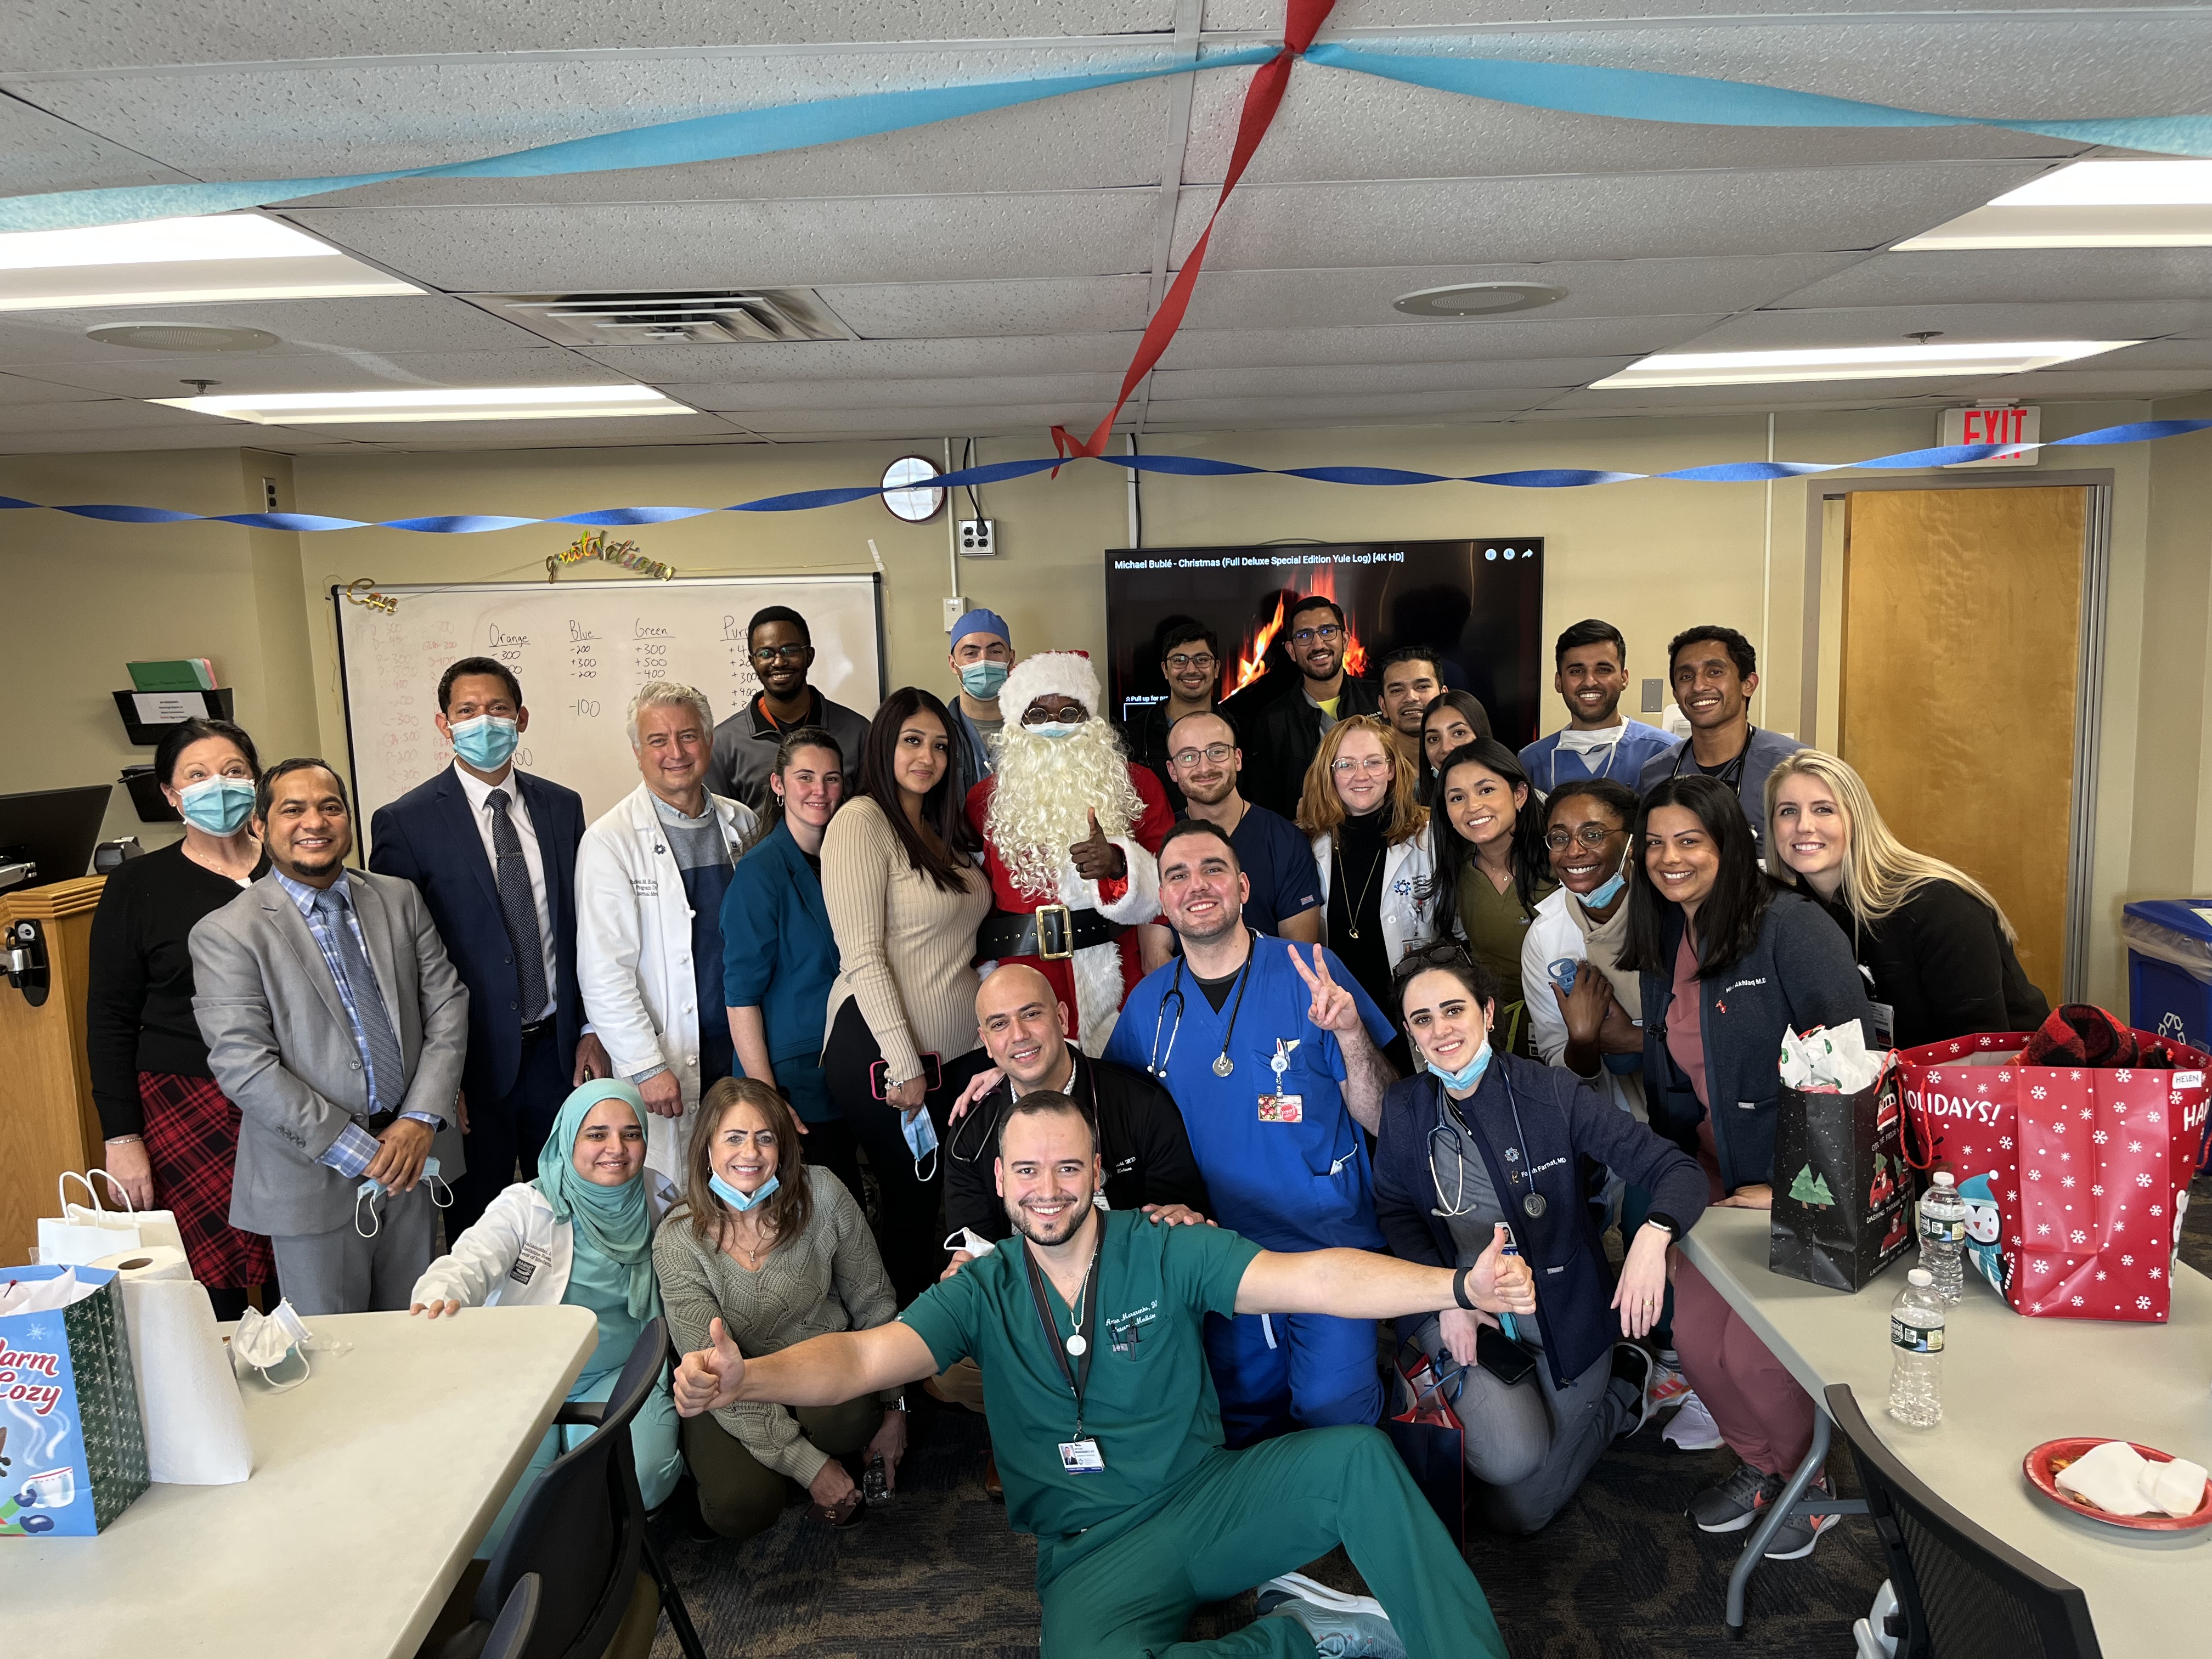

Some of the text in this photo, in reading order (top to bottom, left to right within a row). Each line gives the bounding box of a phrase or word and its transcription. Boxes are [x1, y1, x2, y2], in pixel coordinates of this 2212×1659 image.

[1963, 409, 2028, 459] EXIT
[1115, 560, 1147, 569] Michael
[1149, 559, 1172, 568] Bublé
[1178, 558, 1221, 567] Christmas
[1222, 557, 1240, 568] (Full
[1242, 556, 1269, 566] Deluxe
[1271, 555, 1301, 566] Special
[1303, 555, 1331, 564] Edition
[1333, 554, 1351, 563] Yule
[1353, 553, 1372, 565] Log)
[1373, 552, 1386, 563] [4K
[1389, 552, 1404, 562] HD]
[346, 578, 398, 615] Con
[489, 623, 529, 647] Orange
[569, 619, 595, 641] Blue
[635, 618, 668, 637] Green
[635, 644, 666, 654] +300
[729, 645, 749, 658] +4
[505, 664, 522, 674] 00
[635, 657, 667, 667] +500
[569, 699, 600, 717] -100
[2176, 1075, 2199, 1084] HELEN
[1537, 1159, 1558, 1173] Farhat,
[1866, 1211, 1885, 1224] DASHING
